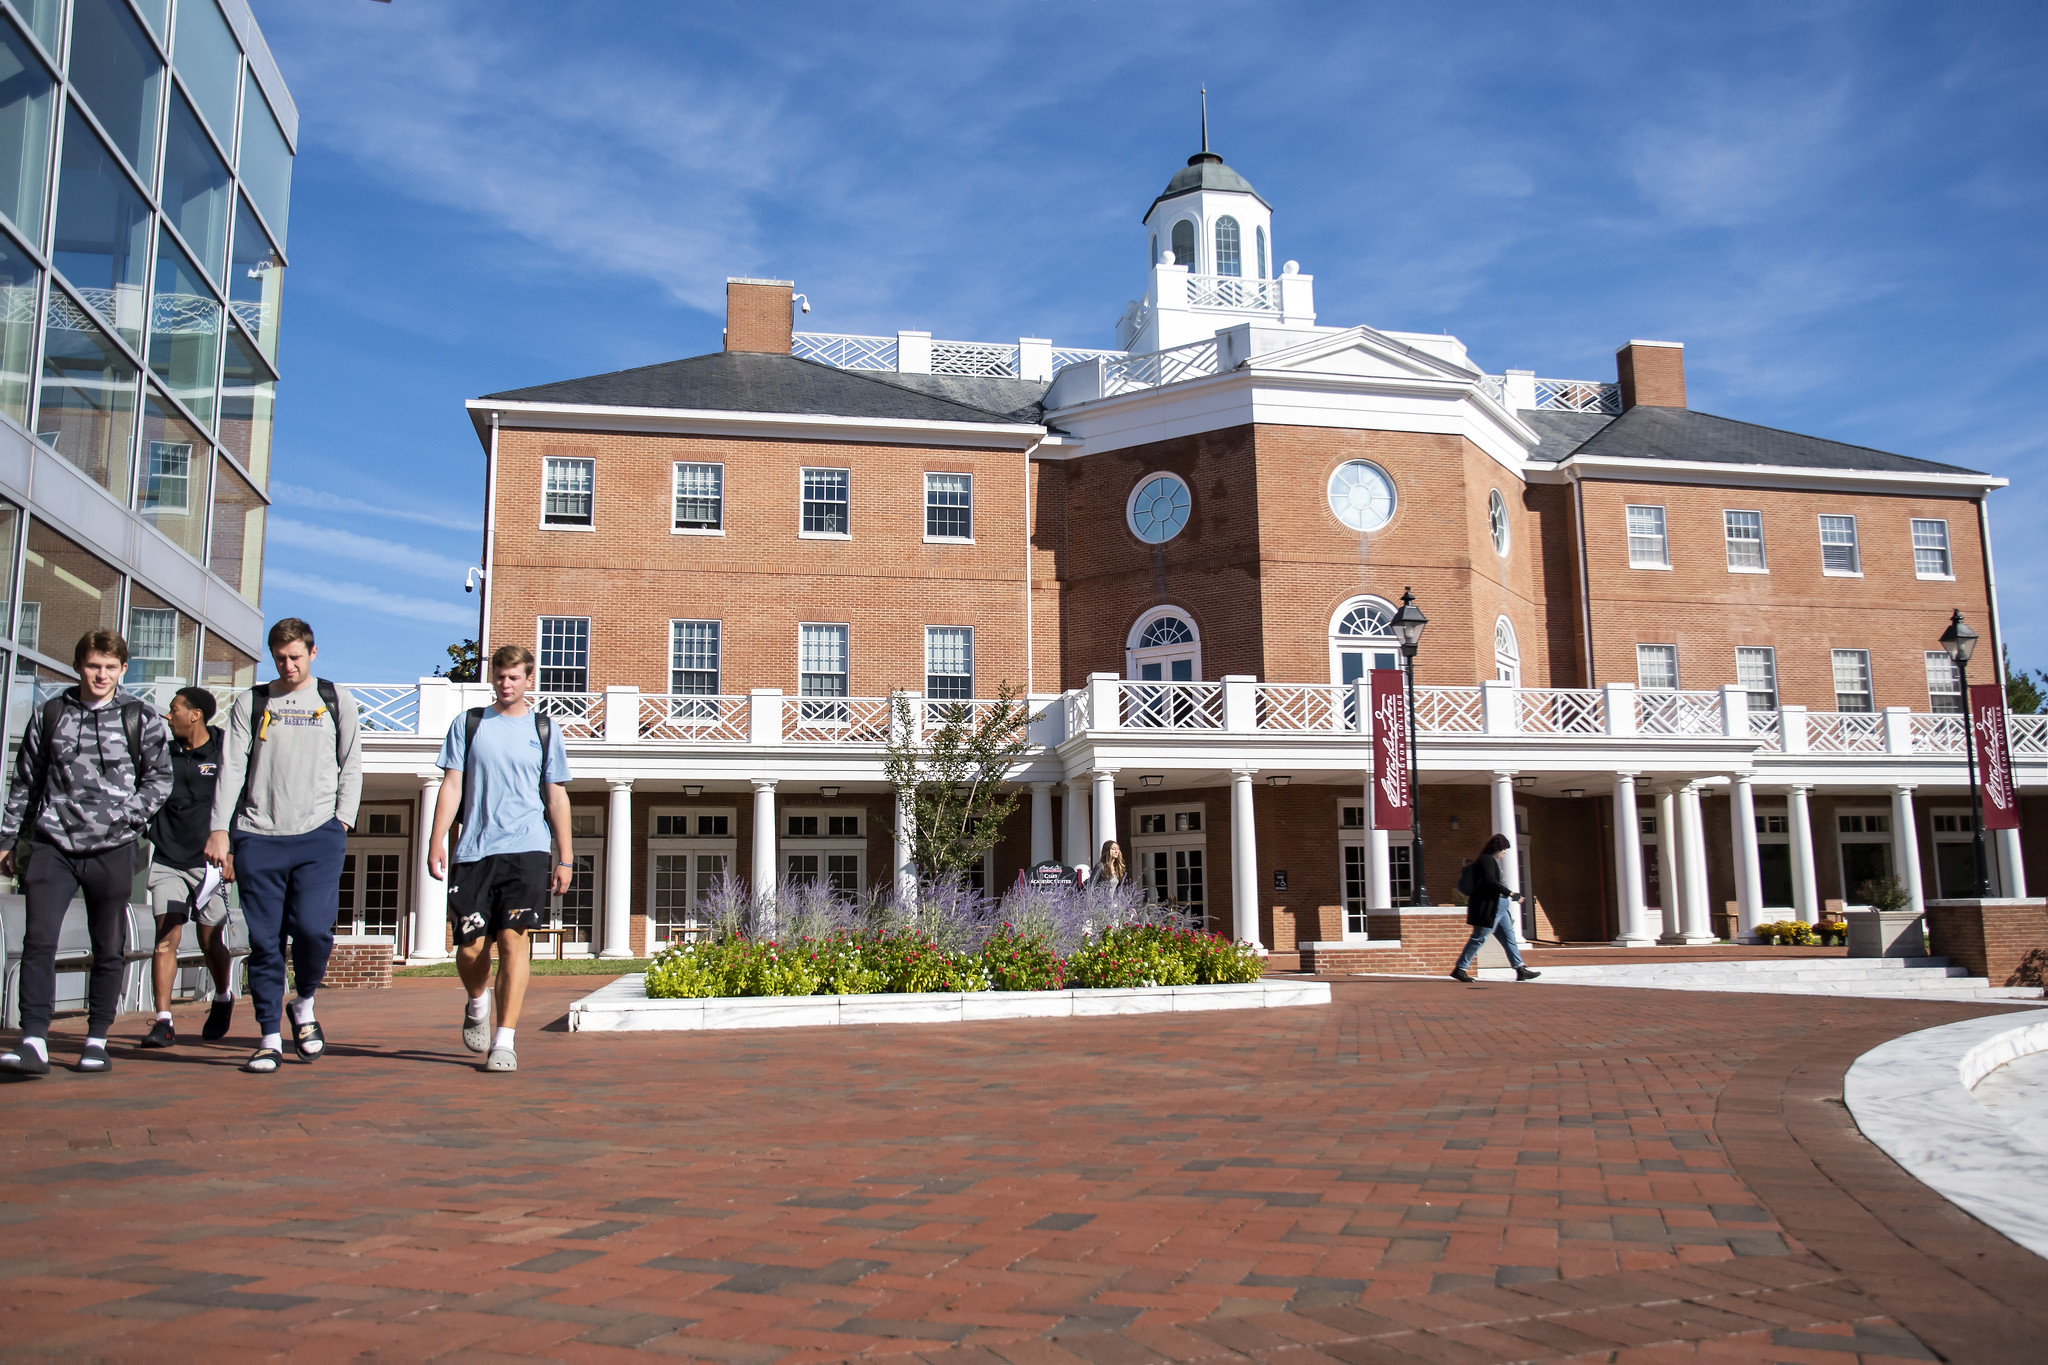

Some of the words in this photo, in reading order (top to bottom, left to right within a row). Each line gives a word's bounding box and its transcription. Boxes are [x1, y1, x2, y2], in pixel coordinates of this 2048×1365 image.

[284, 717, 323, 727] BASKETBALL
[1397, 694, 1405, 737] COLLEGE
[1996, 706, 2005, 745] COLLEGE
[1399, 743, 1408, 807] WASHINGTON
[2001, 750, 2014, 809] WASHINGTON
[461, 912, 486, 934] 23
